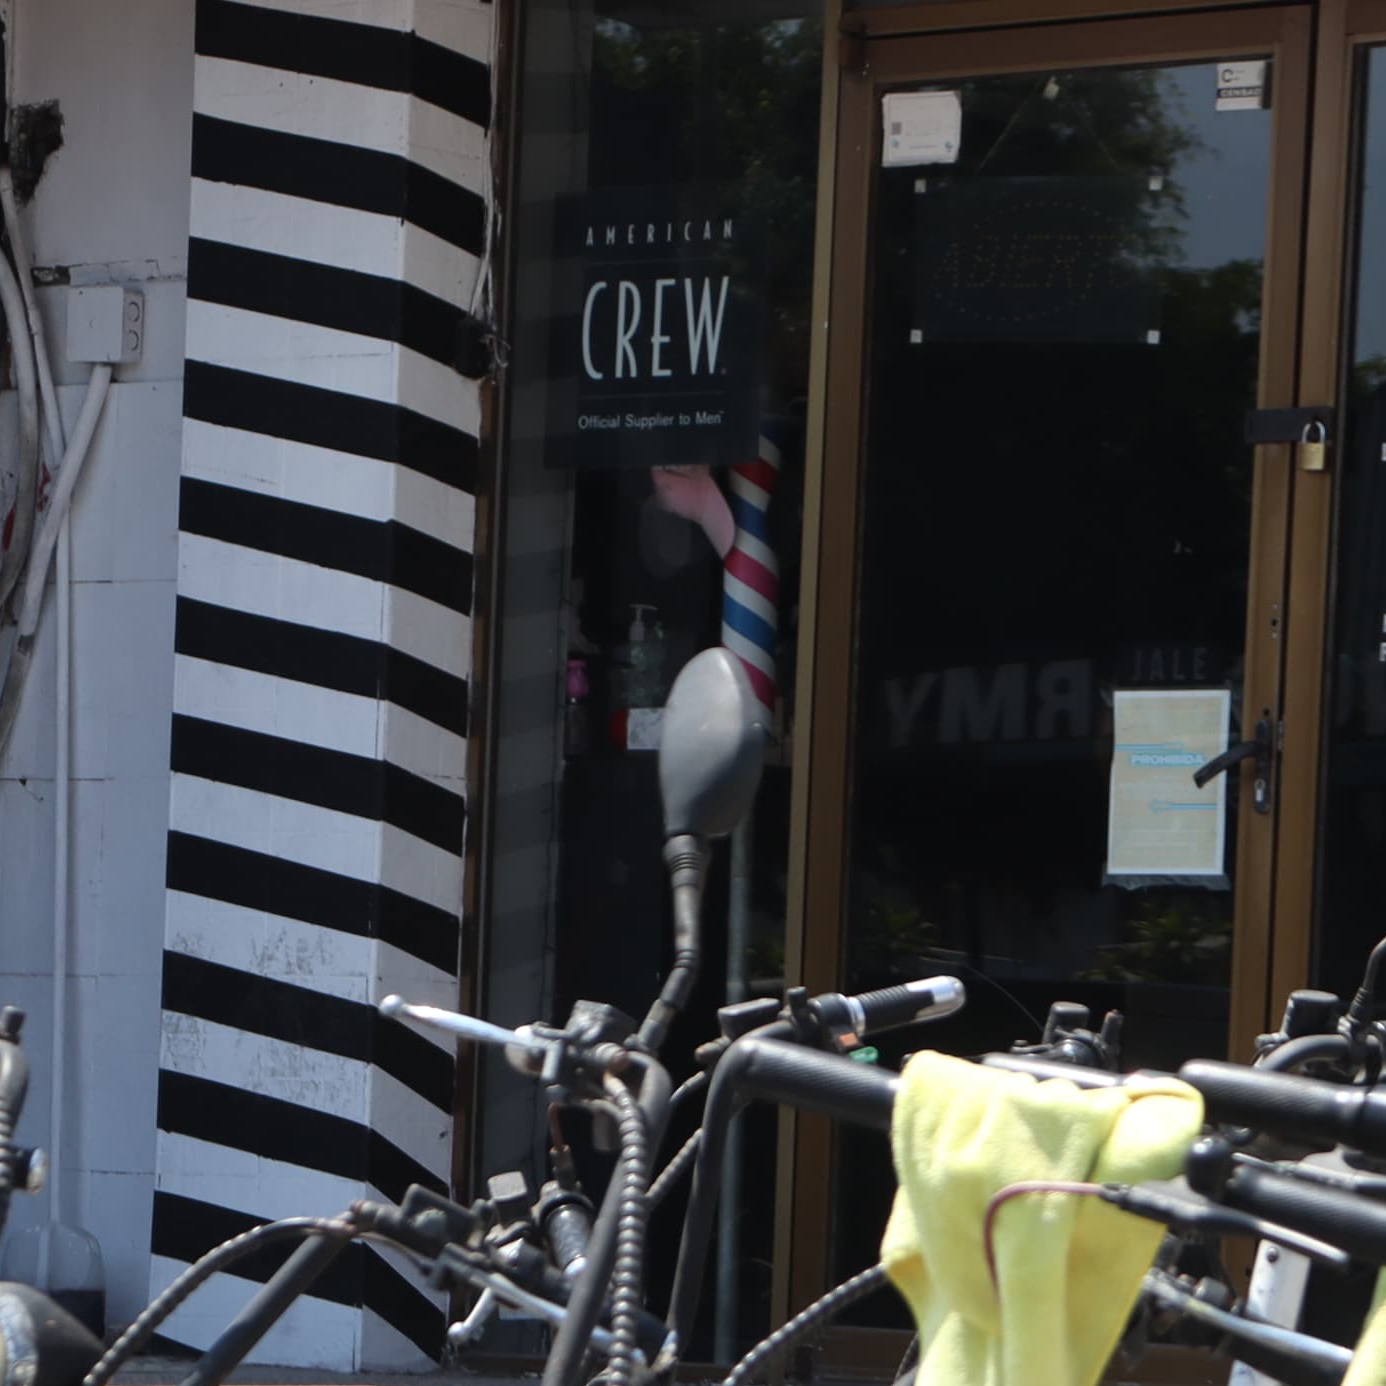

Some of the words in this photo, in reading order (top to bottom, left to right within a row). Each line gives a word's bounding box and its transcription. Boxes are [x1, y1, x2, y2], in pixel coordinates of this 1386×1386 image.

[585, 219, 734, 247] AMERICAN
[581, 275, 730, 381] CREW
[578, 414, 621, 430] Official
[625, 412, 674, 431] Supplier
[679, 413, 691, 426] to
